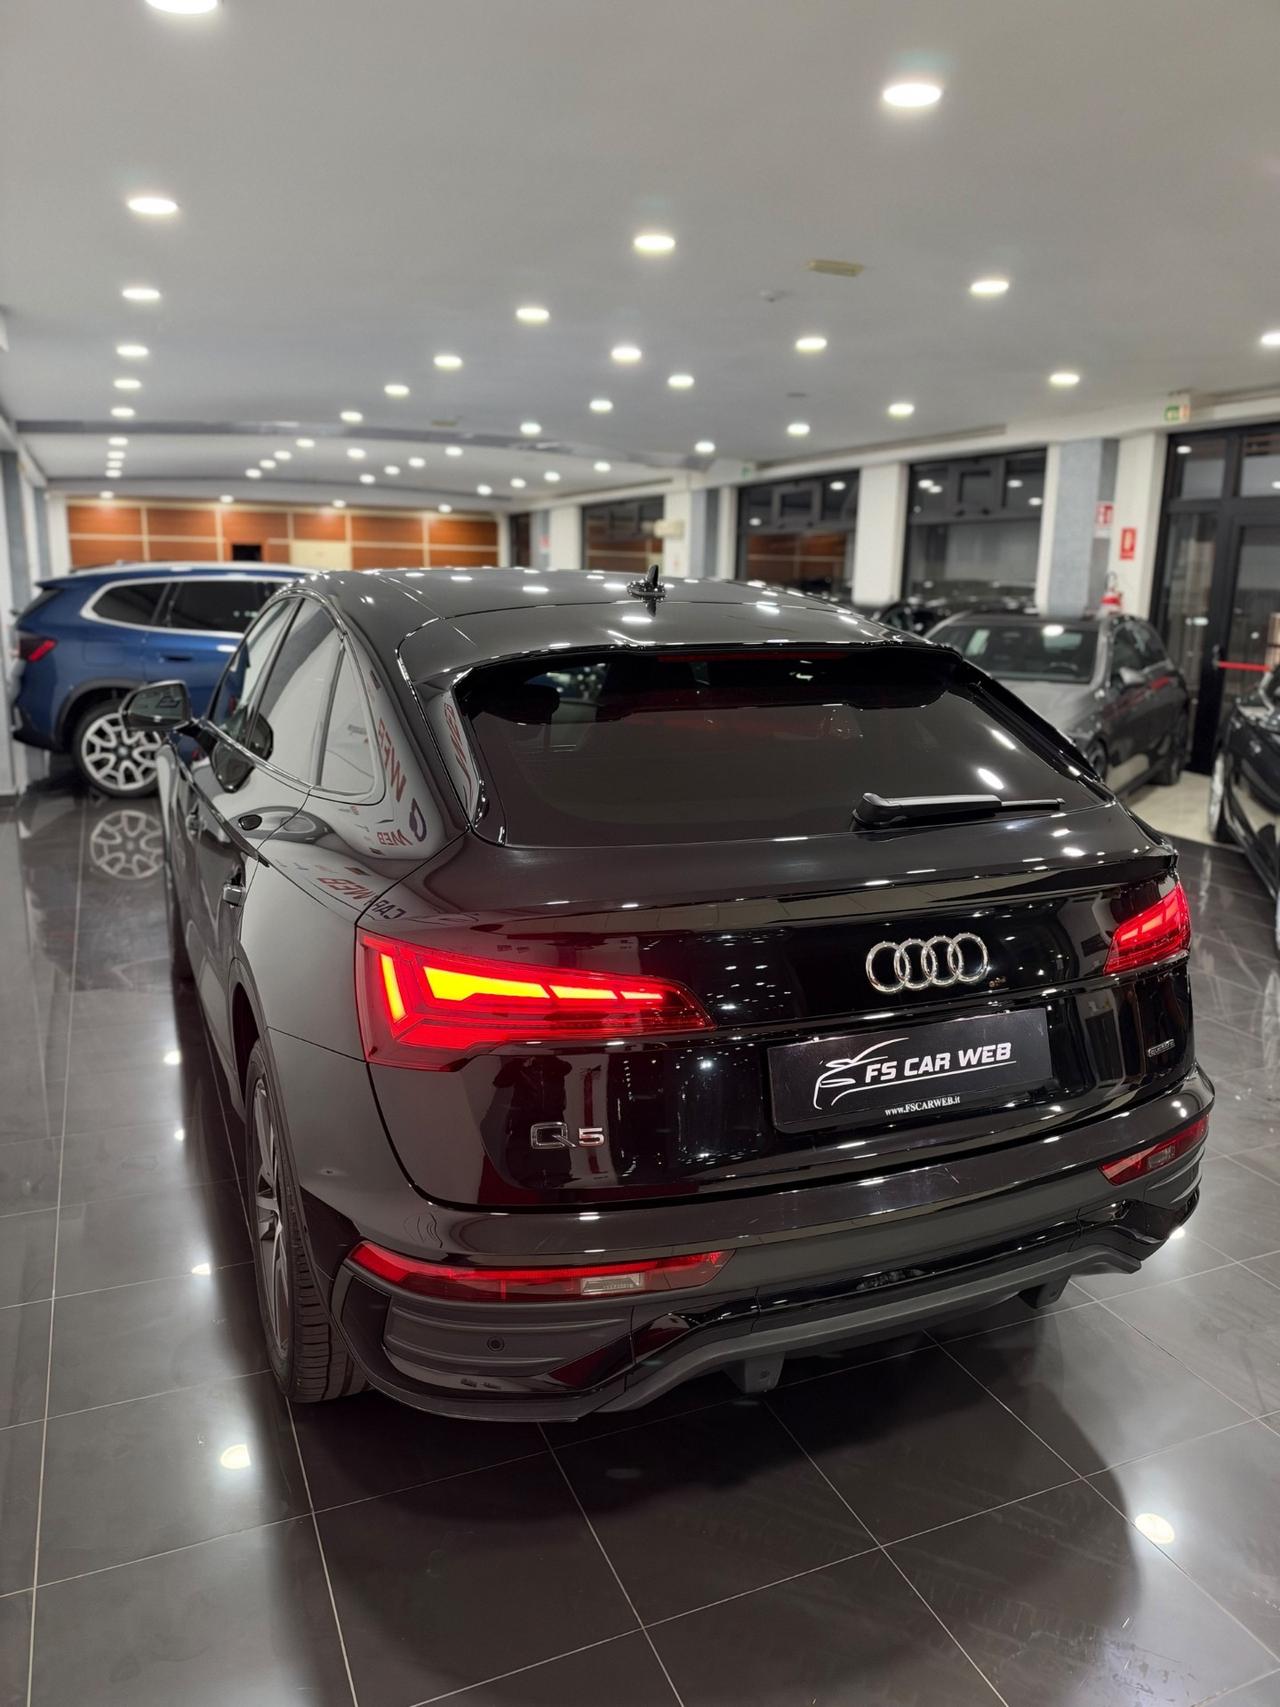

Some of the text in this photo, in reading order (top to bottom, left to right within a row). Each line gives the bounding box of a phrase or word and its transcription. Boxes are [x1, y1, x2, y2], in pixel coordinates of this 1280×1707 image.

[866, 1042, 1012, 1083] FS CAR WEB
[885, 1096, 961, 1116] www.FSCARWEB.it
